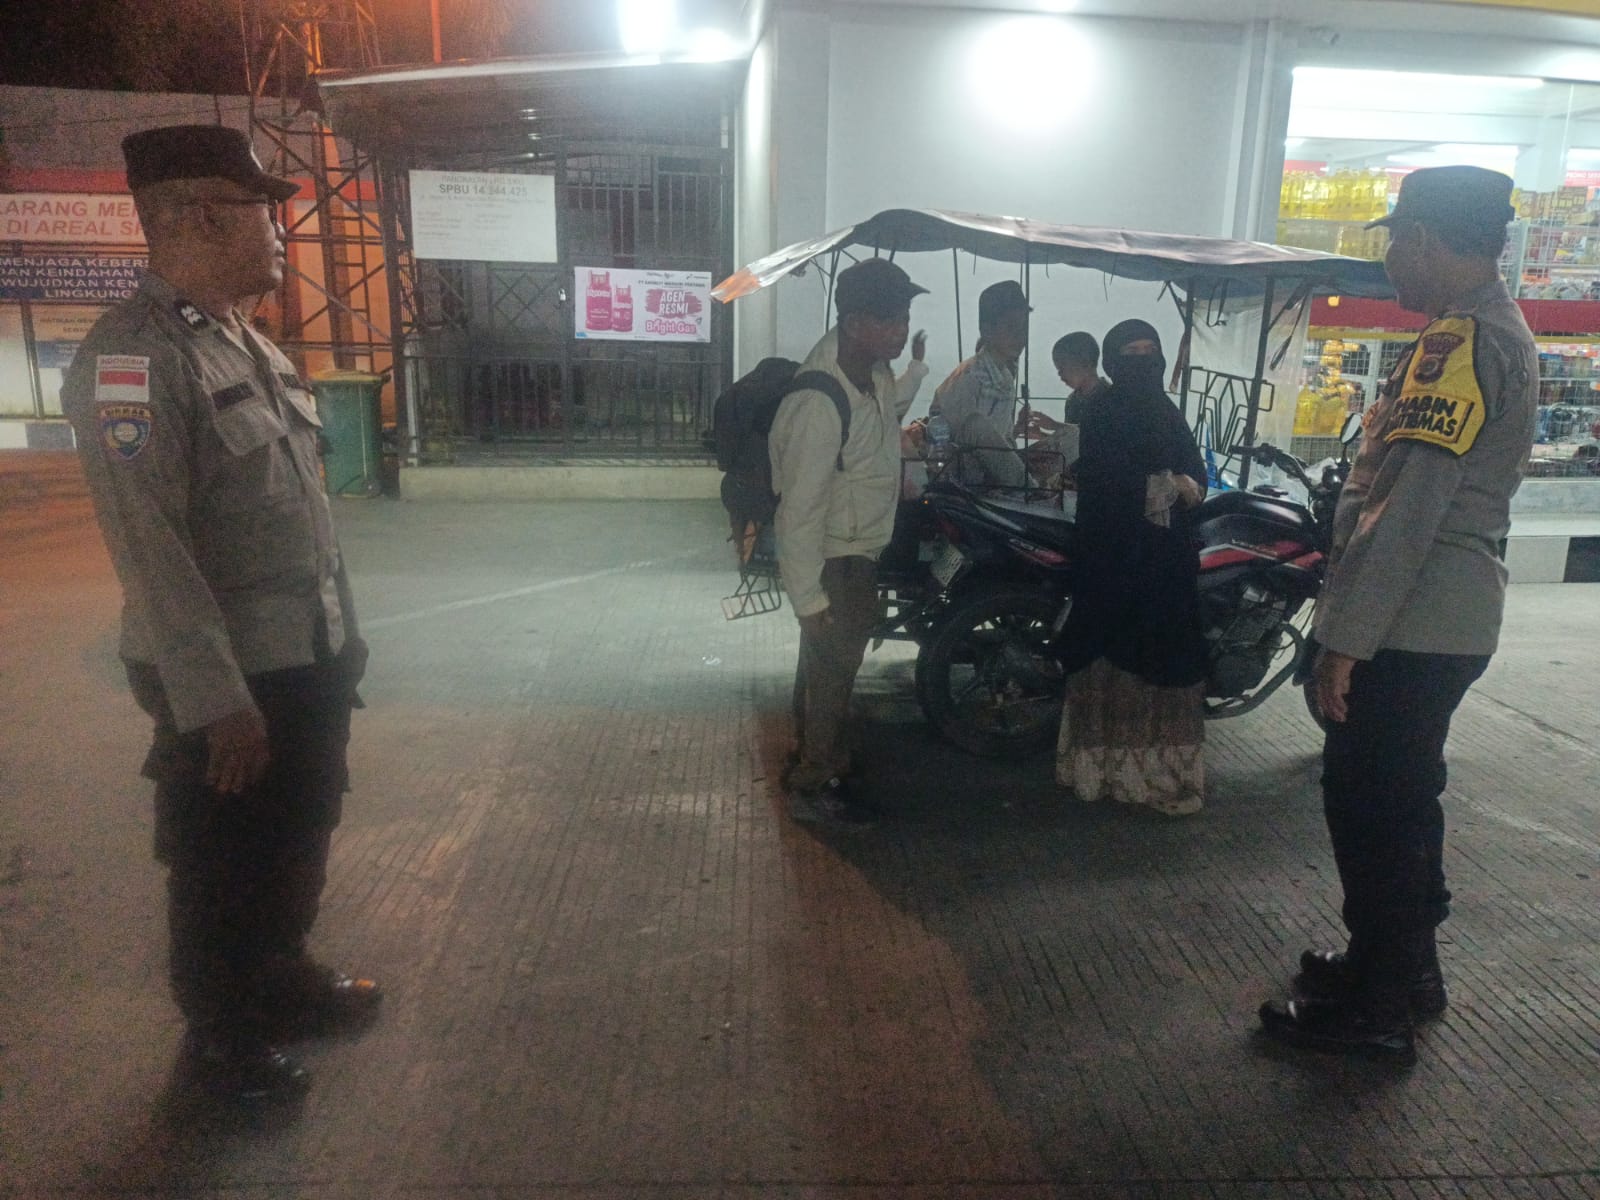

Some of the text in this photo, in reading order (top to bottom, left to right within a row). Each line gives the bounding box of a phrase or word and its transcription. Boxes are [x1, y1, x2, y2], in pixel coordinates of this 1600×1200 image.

[439, 184, 469, 195] SPBU
[0, 200, 87, 217] ARANG
[7, 220, 28, 234] DI
[35, 220, 112, 236] AREAL
[36, 268, 134, 277] KEINDAHAN
[661, 291, 685, 303] AGEN
[659, 303, 689, 314] RESMI
[645, 318, 697, 334] Bright Gas
